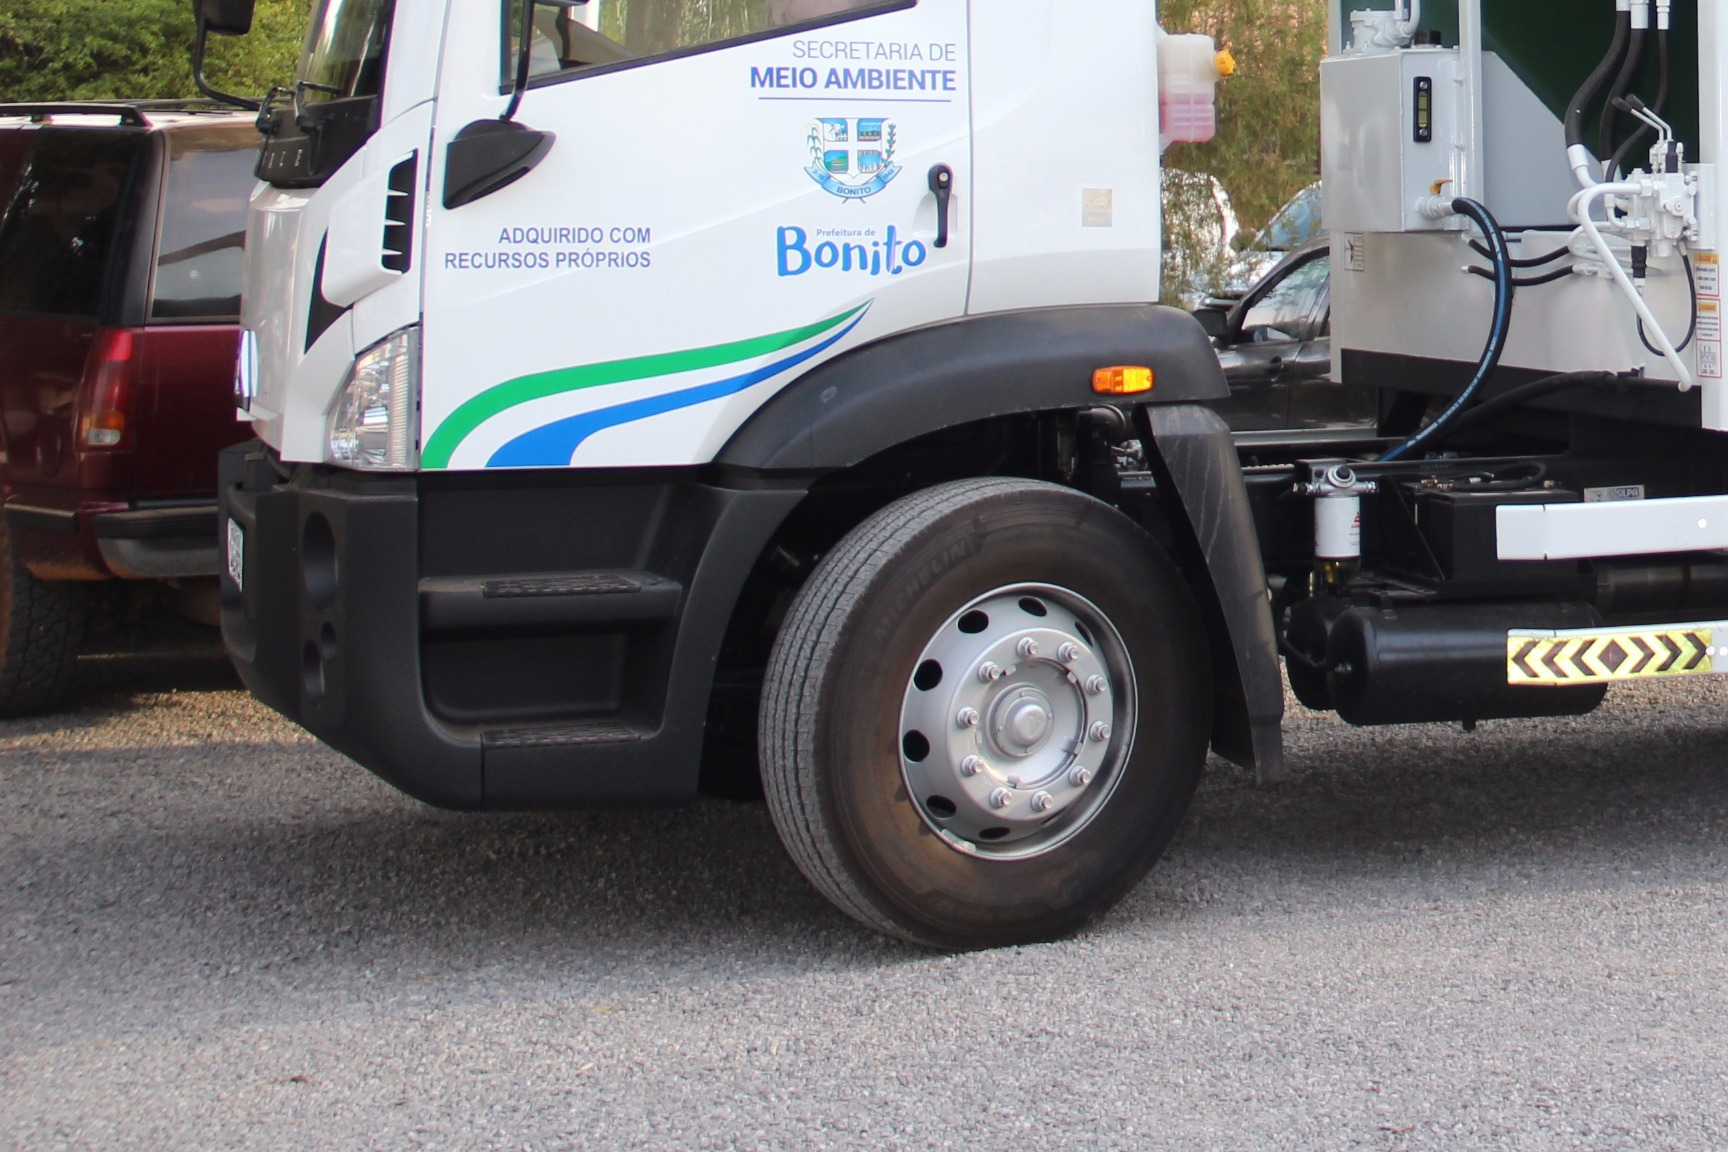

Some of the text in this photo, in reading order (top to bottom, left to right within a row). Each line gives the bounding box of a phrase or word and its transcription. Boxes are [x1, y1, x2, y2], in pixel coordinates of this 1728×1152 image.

[792, 40, 957, 62] SECRETARIA DE
[750, 66, 957, 92] MEIO AMBIENTE
[836, 186, 872, 196] BONITO
[499, 227, 651, 244] ADQUIRIDO COM
[816, 228, 876, 237] Prefeitura de
[444, 248, 651, 269] RECURSOS PRÓPRIOS
[777, 225, 926, 277] Bonito
